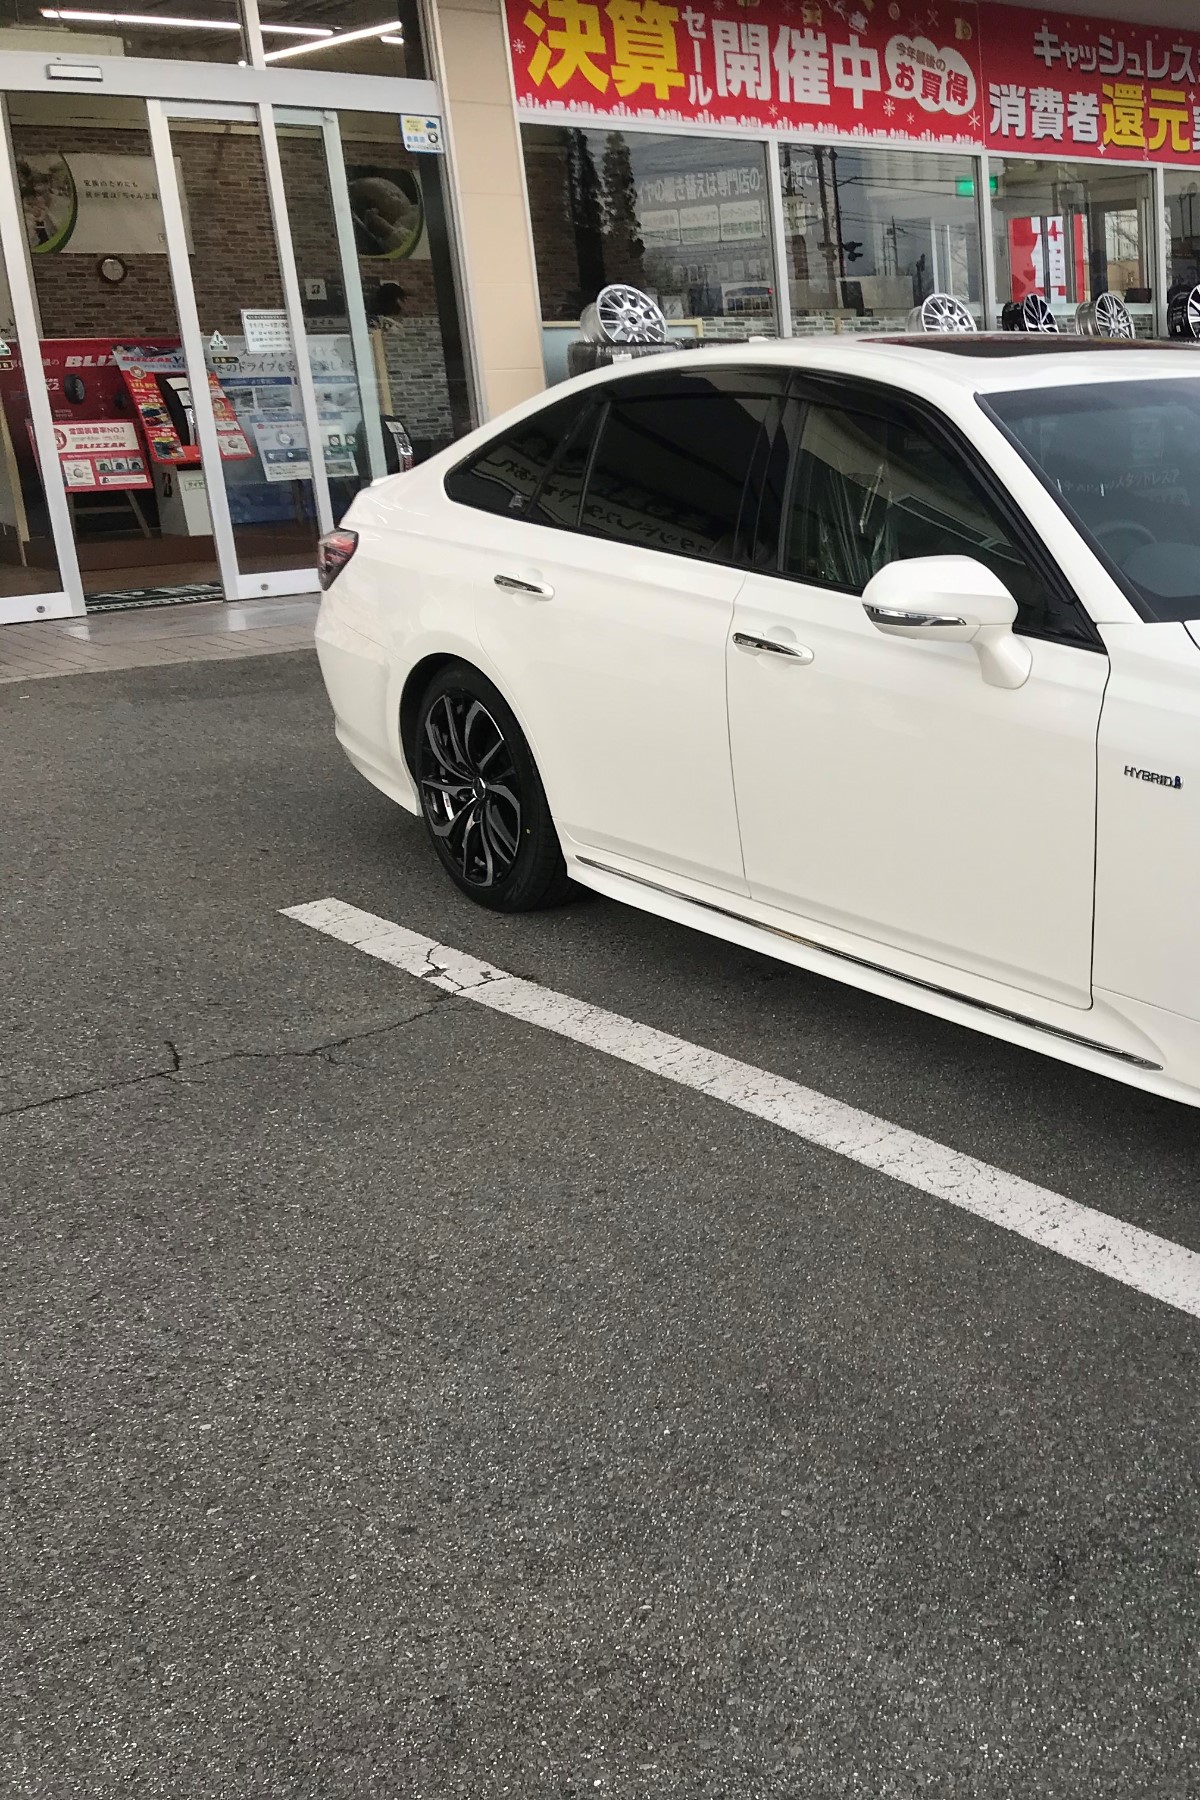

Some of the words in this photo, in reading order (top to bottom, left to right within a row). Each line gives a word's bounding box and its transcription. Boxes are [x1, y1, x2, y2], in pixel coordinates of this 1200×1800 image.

[523, 0, 685, 100] 決算
[682, 5, 713, 106] セール
[712, 20, 882, 109] 開催中
[895, 40, 947, 73] 今年最後の
[894, 61, 970, 107] お買得
[1123, 765, 1173, 788] HYBRID
